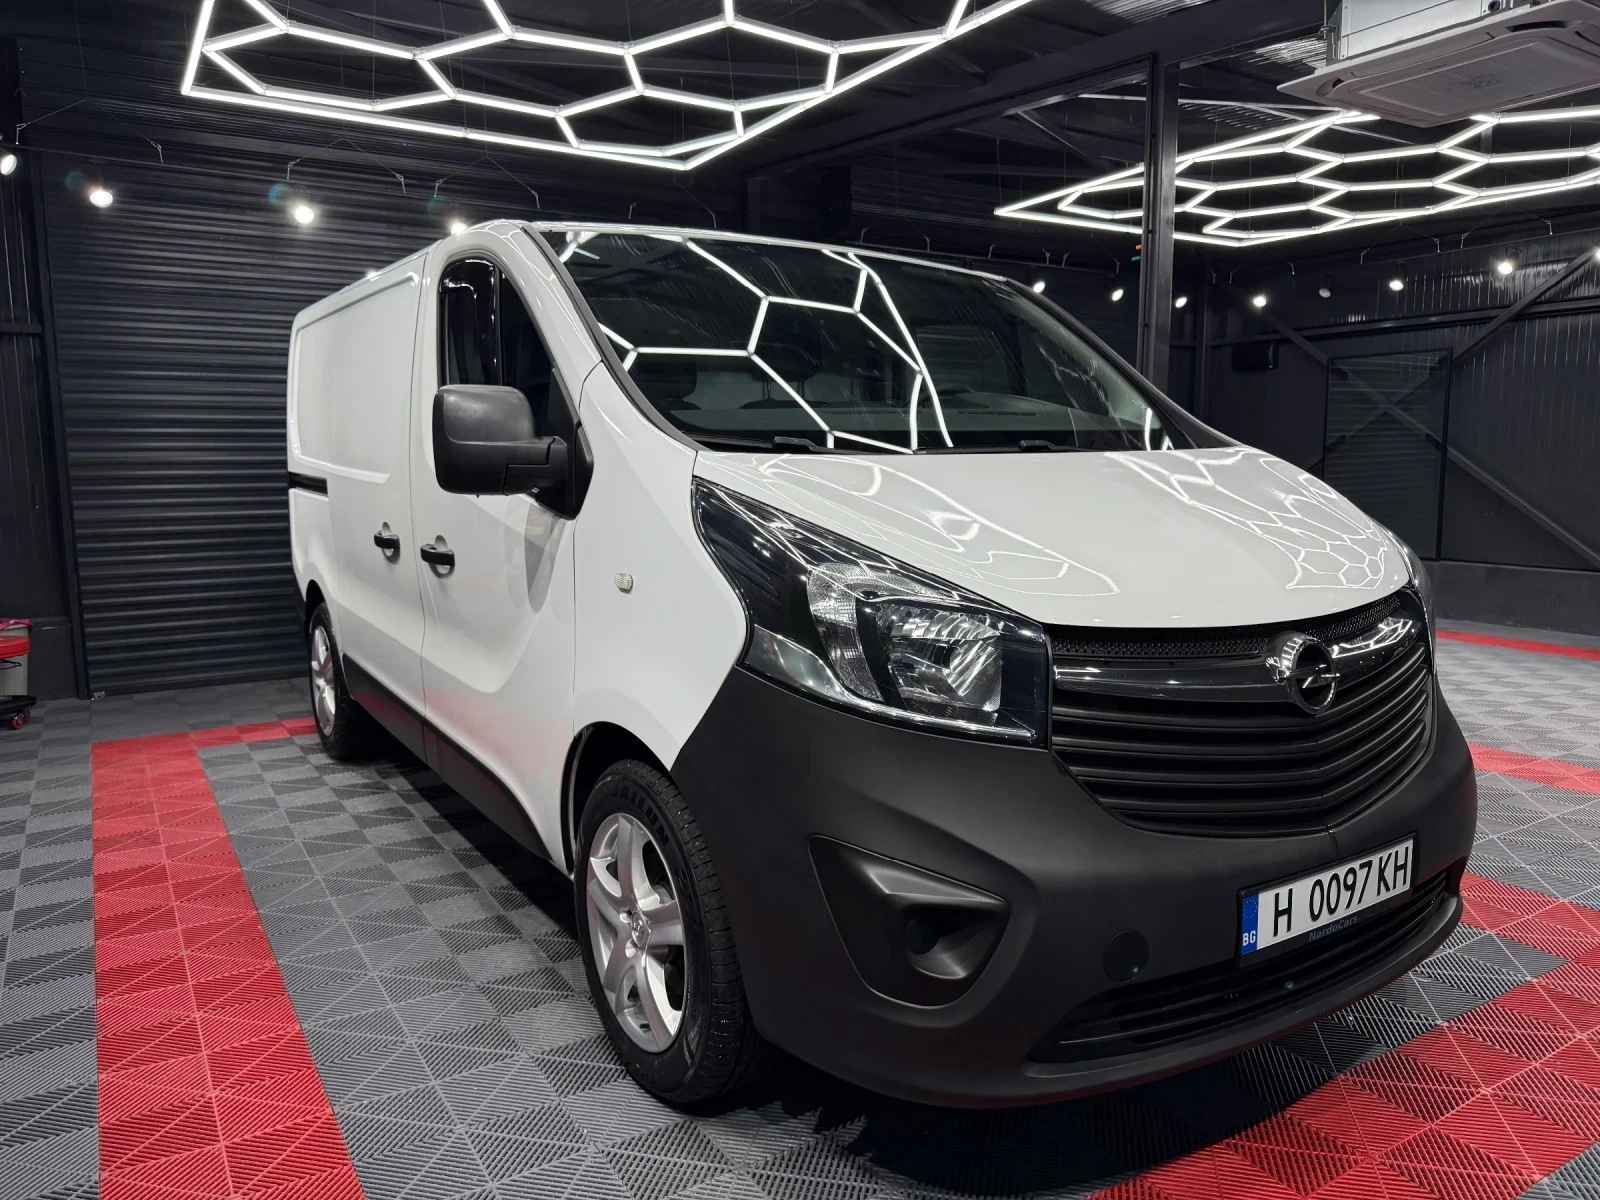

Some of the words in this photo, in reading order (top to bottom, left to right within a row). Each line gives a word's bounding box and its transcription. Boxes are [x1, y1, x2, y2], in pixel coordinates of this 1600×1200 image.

[1273, 888, 1294, 938] H
[1242, 930, 1256, 947] BG
[1308, 915, 1359, 942] NardoCars
